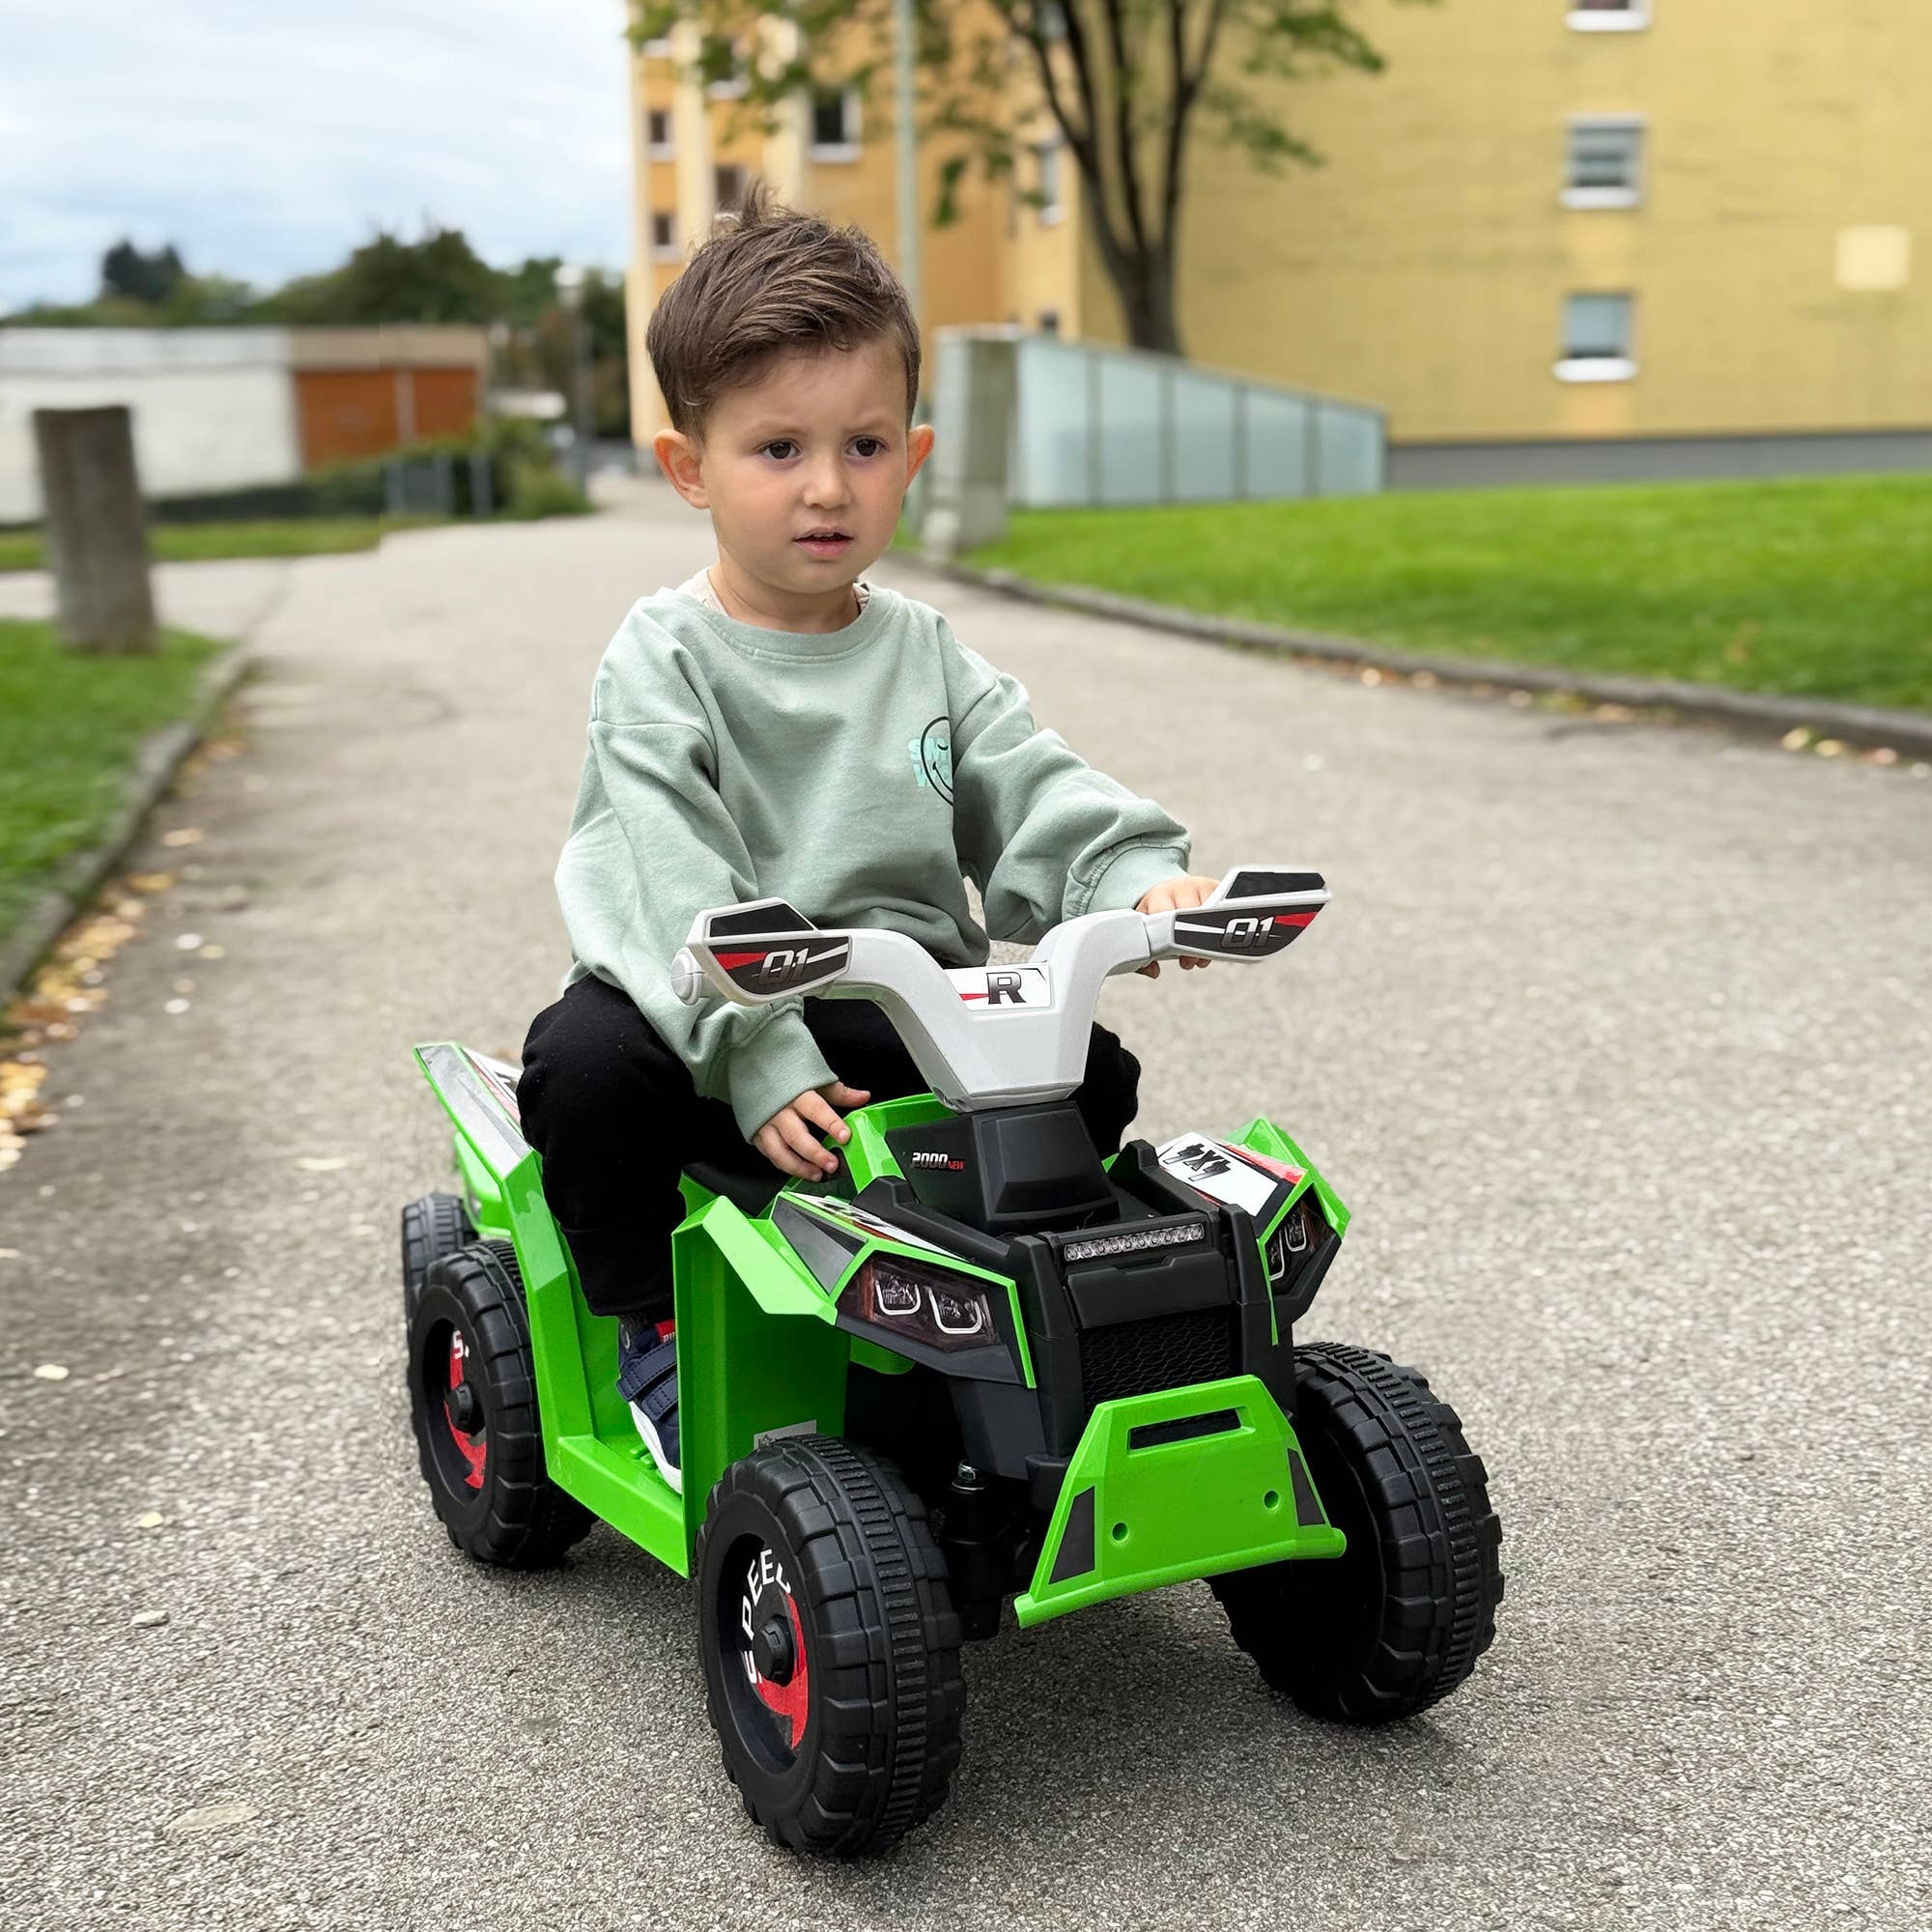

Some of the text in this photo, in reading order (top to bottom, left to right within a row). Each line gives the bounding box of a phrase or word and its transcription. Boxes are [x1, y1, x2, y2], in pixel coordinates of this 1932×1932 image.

[1221, 917, 1274, 948] 01
[758, 948, 809, 984] 01
[986, 972, 1027, 1005] R
